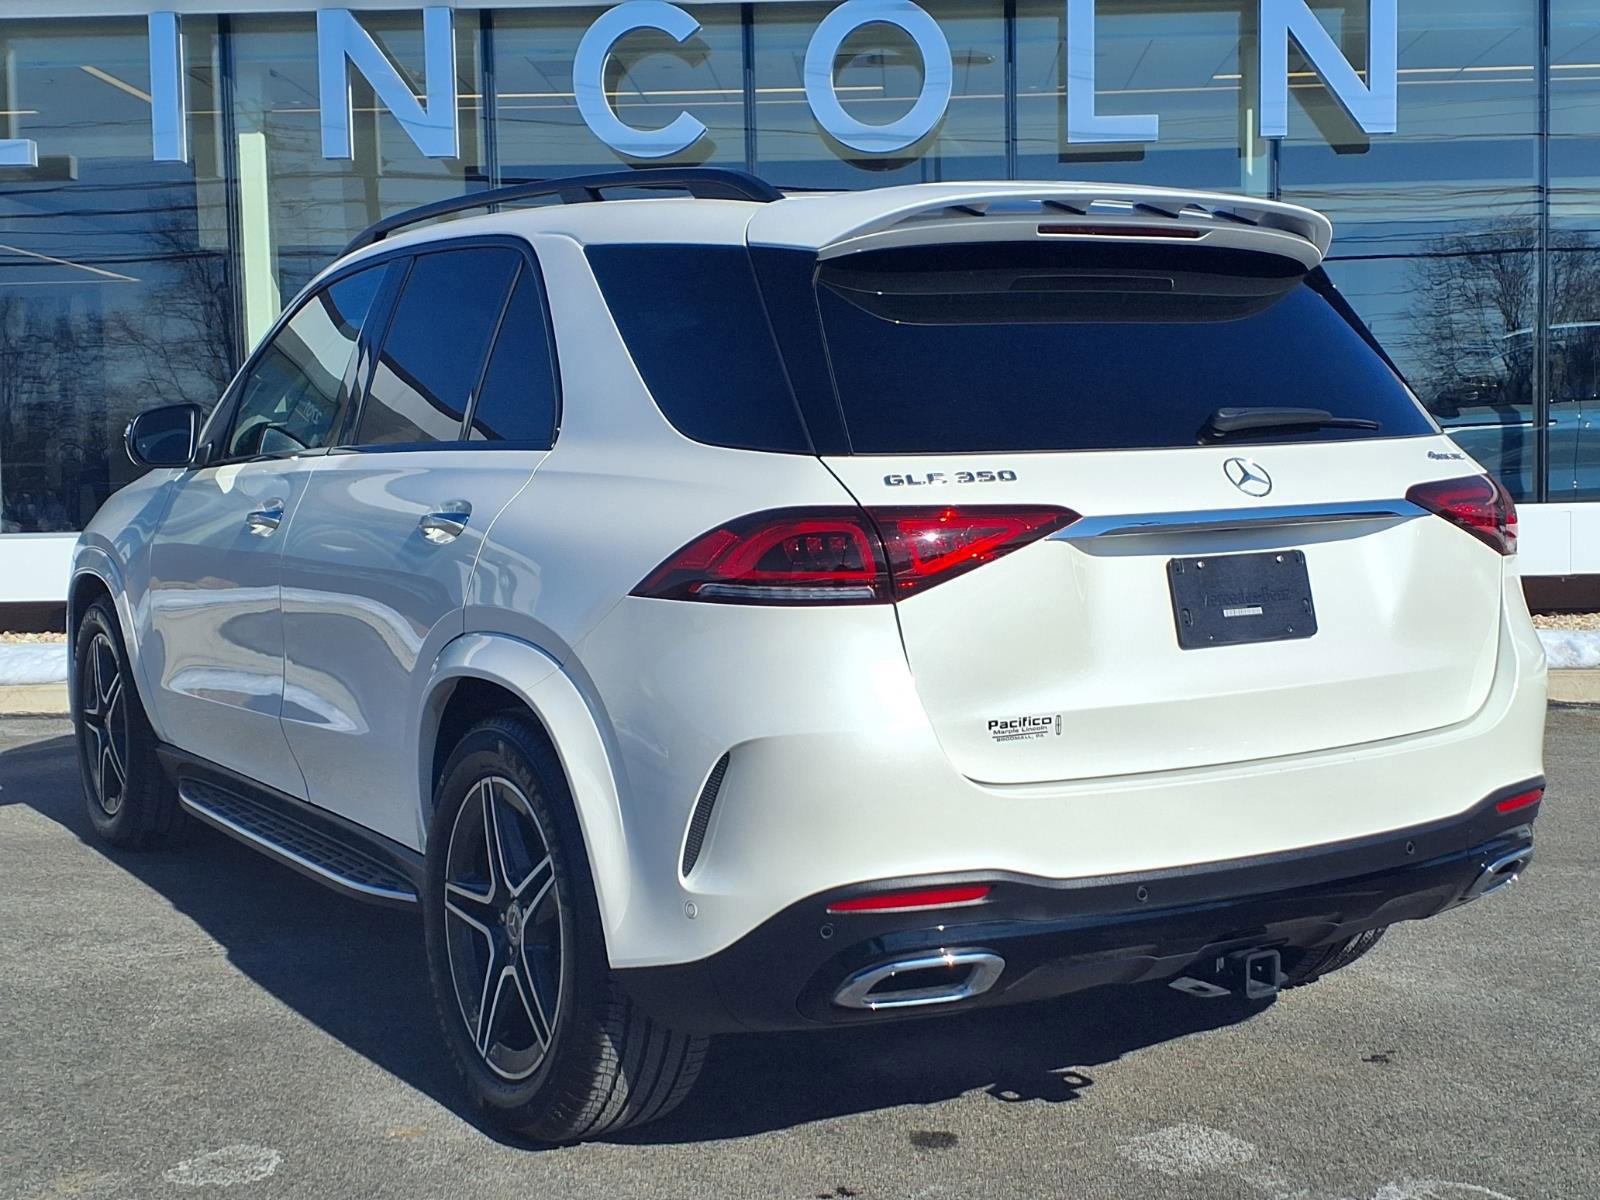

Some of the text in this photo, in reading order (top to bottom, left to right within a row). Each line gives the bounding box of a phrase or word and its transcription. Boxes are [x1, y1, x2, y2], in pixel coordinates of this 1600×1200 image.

[0, 0, 1398, 168] INCOLN
[954, 469, 1018, 484] 350
[988, 716, 1052, 731] Pacifico
